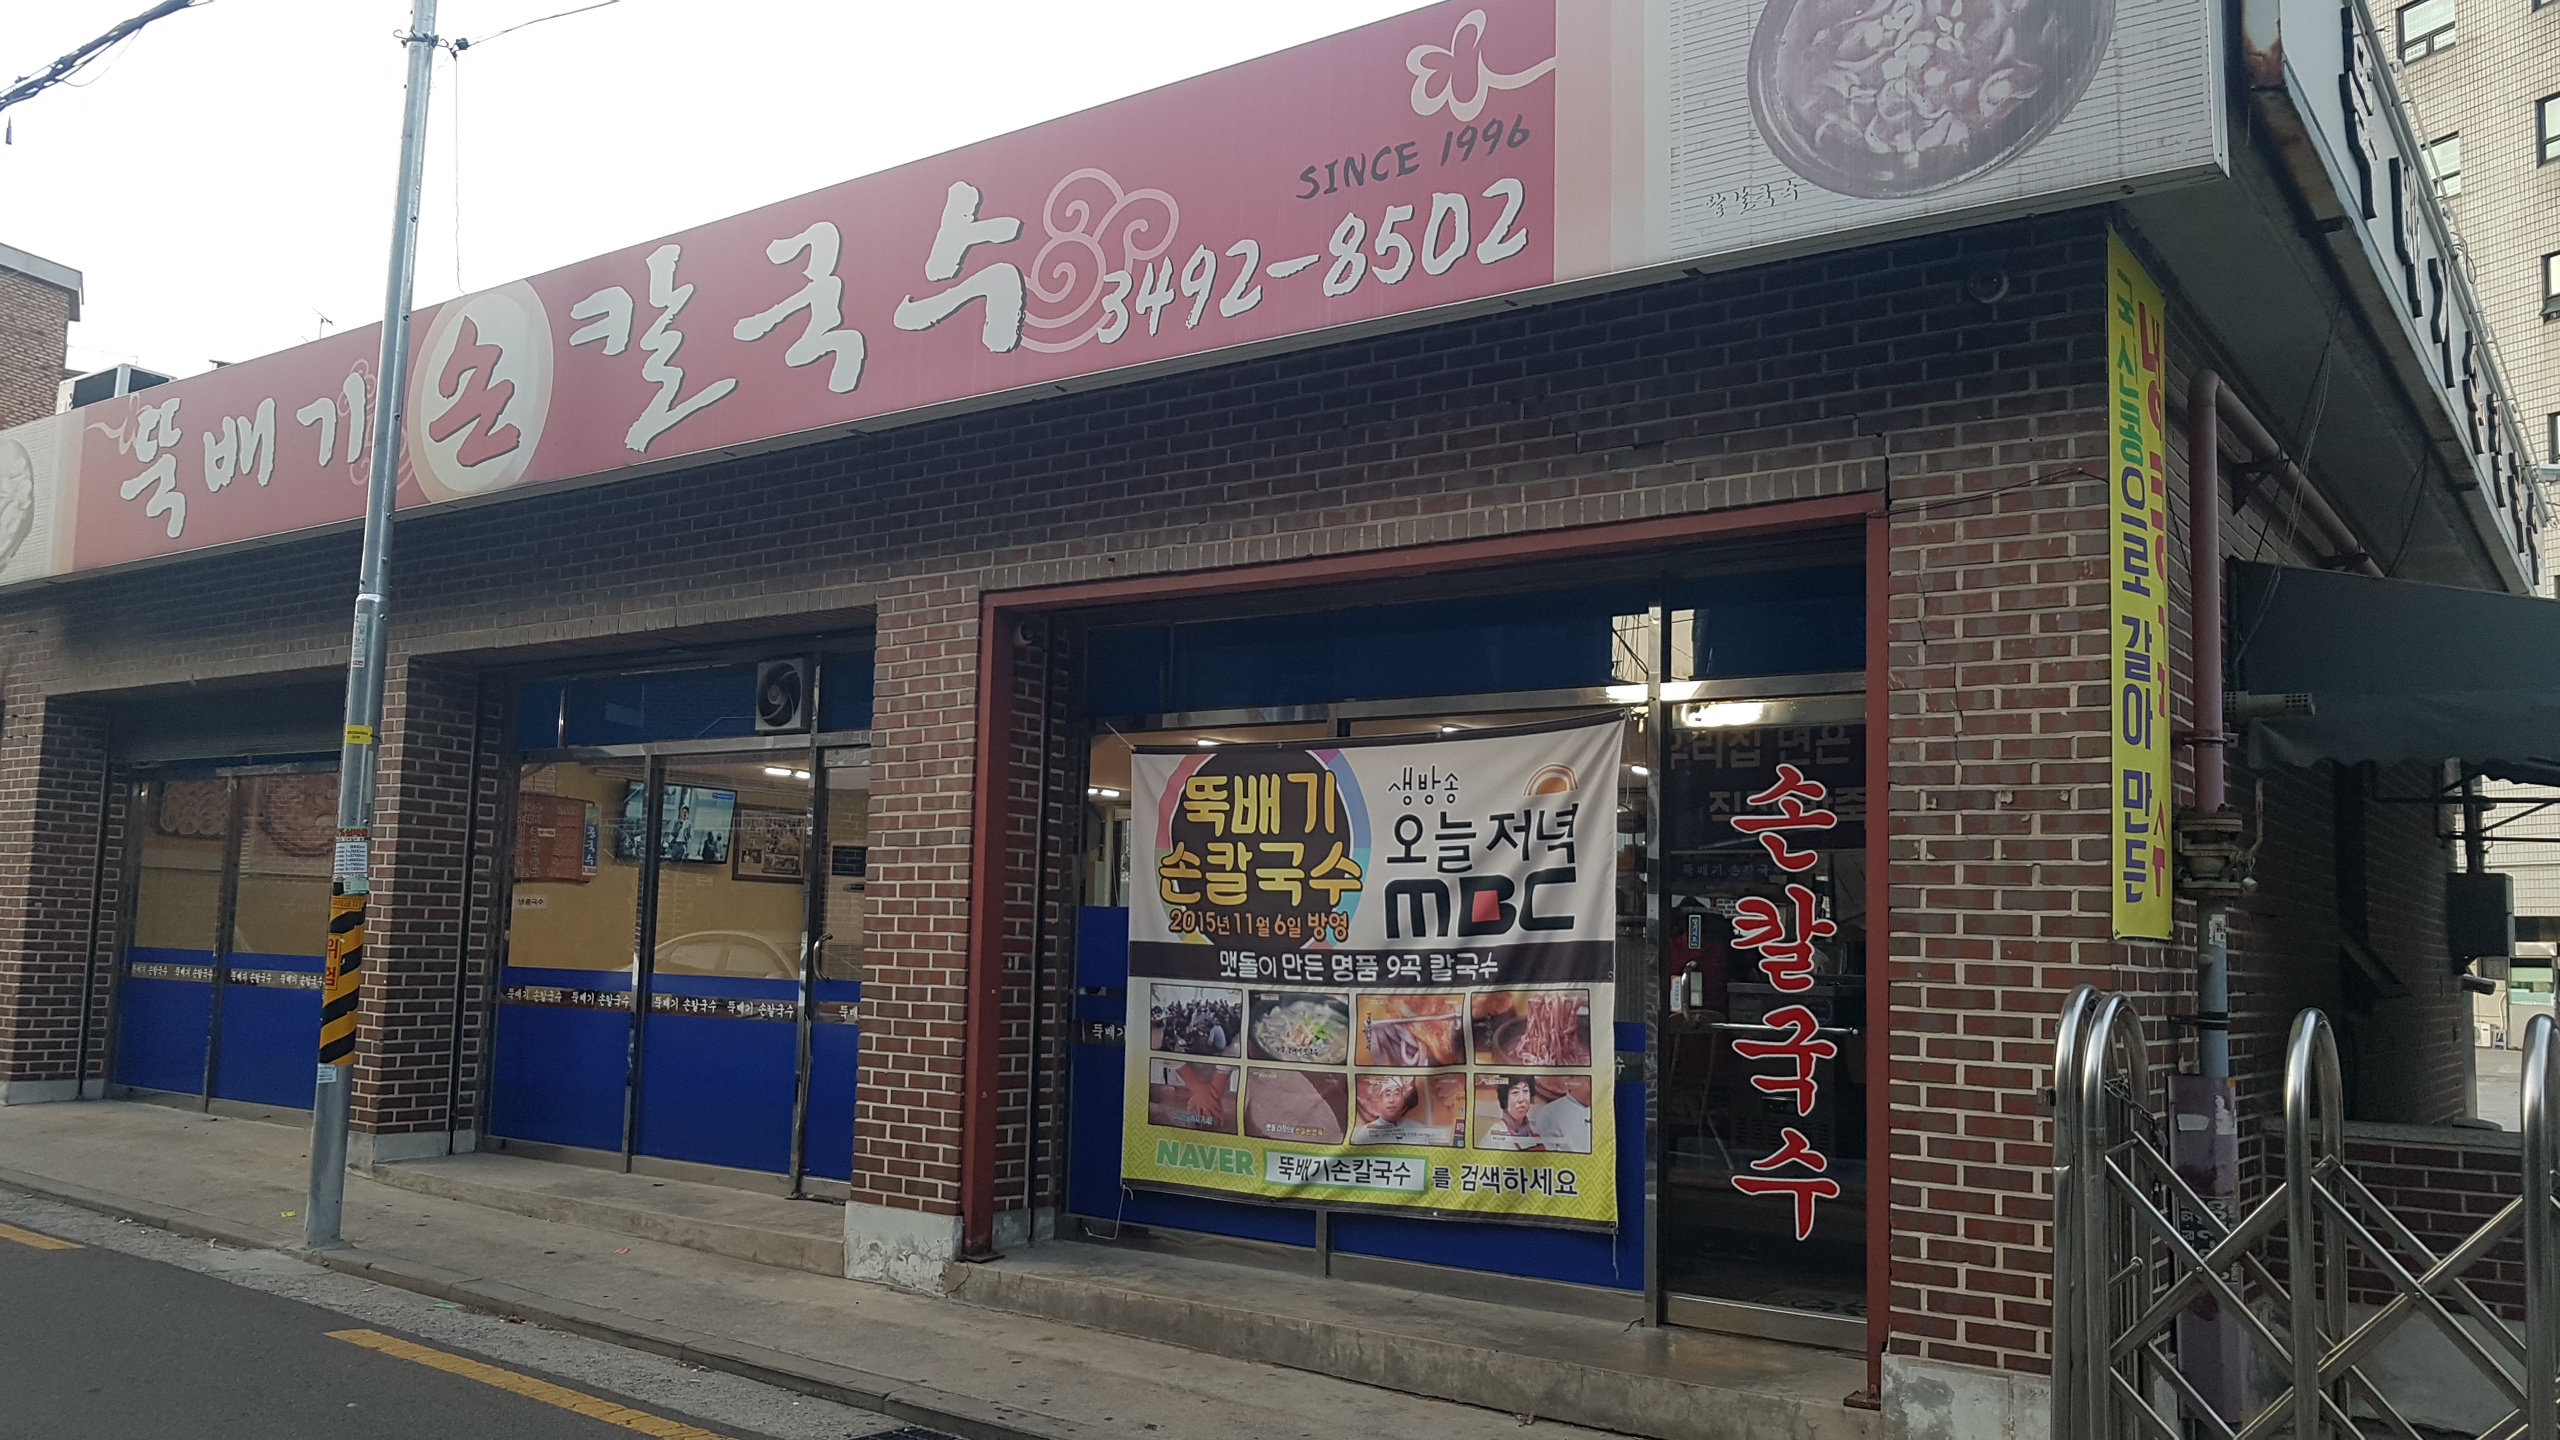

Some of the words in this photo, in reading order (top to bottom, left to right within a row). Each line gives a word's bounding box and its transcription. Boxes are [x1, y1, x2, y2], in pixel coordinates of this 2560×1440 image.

[1296, 140, 1420, 200] SINCE
[1439, 114, 1530, 167] 1996
[1098, 178, 1529, 345] 3492-8502
[120, 372, 367, 539] 뚝배기
[429, 315, 521, 468] 손
[570, 180, 1023, 453] 칼국수
[2121, 614, 2153, 750] 갈아
[1183, 771, 1338, 838] 뚝배기
[1387, 765, 1461, 805] 생방송
[2122, 768, 2153, 904] 만든
[1157, 840, 1364, 908] 손칼국수
[1169, 910, 1231, 938] 2015년
[1233, 911, 1271, 938] 11월
[1274, 914, 1302, 939] 6일
[1306, 912, 1350, 943] 방영
[1281, 953, 1325, 981] 만든
[1331, 954, 1379, 982] 명품
[1386, 954, 1422, 984] 9곡
[1429, 951, 1499, 982] 칼국수
[1731, 764, 1839, 1240] 손칼국수
[1156, 1139, 1256, 1177] NAVER
[1277, 1154, 1412, 1186] 뚝배기손칼국수
[1432, 1165, 1451, 1190] 를
[1460, 1163, 1578, 1196] 검색하세요
